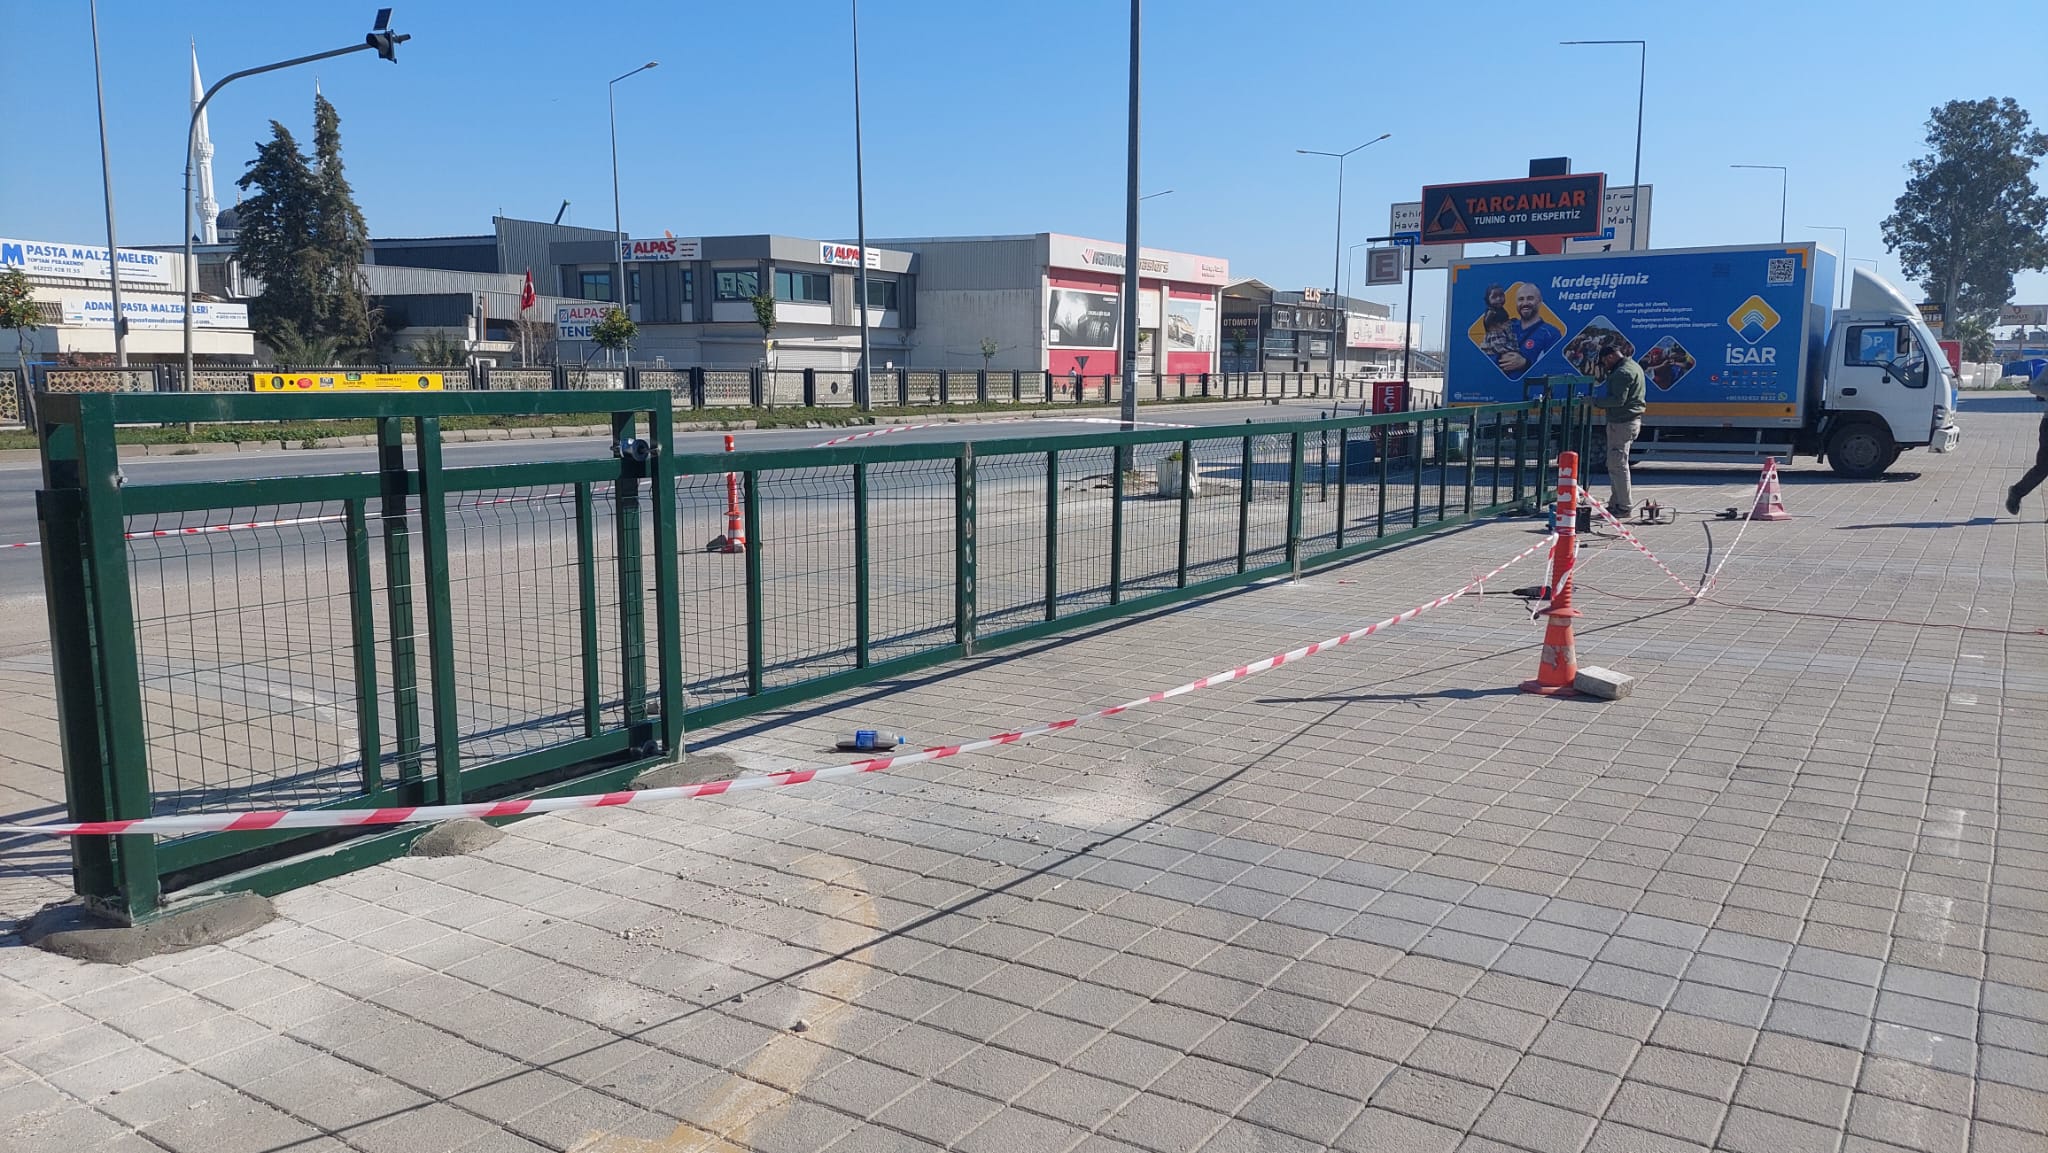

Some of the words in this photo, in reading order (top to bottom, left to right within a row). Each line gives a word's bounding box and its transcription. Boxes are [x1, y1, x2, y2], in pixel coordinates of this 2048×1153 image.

[1466, 190, 1586, 214] TARCANLAR
[1509, 214, 1527, 223] OTO
[1532, 208, 1581, 222] EKSPERTİZ
[26, 244, 67, 258] PASTA
[834, 246, 860, 261] ALPA
[1551, 273, 1650, 290] Kardeşliğimiz
[1558, 290, 1617, 301] Mesafeleri
[84, 301, 113, 311] ADAN
[121, 303, 149, 312] PASTA
[1568, 302, 1595, 313] Aşar
[560, 326, 593, 337] TENE
